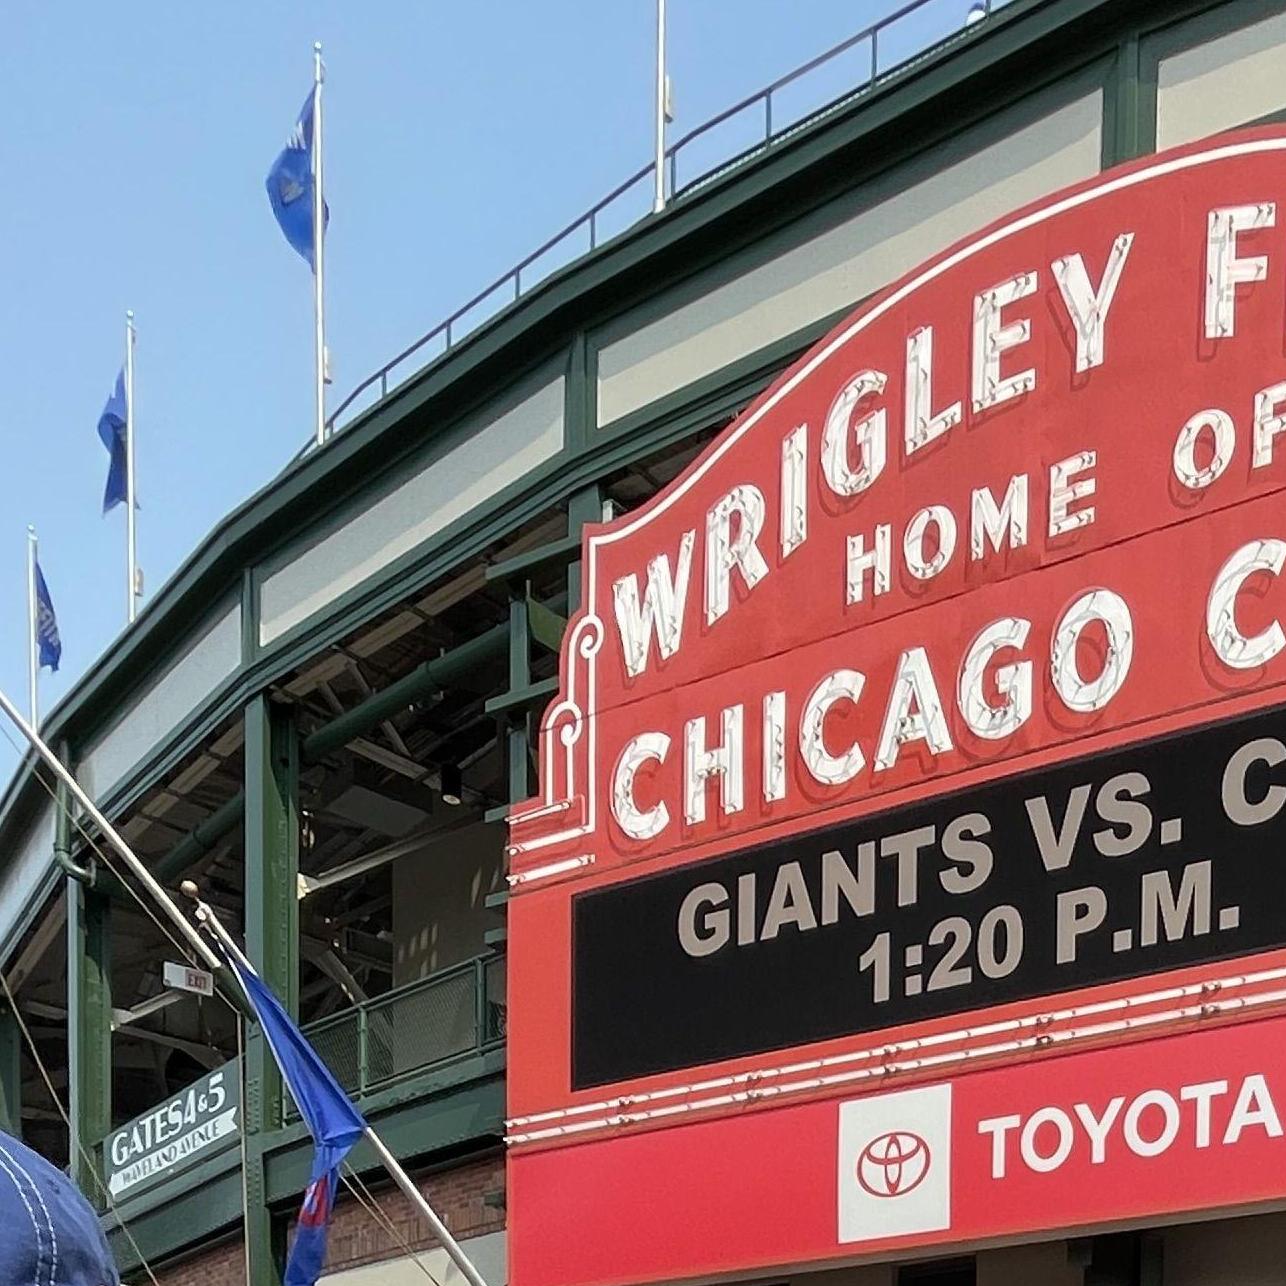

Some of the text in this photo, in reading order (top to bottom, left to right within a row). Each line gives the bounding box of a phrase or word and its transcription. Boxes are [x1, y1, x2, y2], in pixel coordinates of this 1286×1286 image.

[612, 232, 1134, 677] WRIGLEY
[846, 451, 1097, 605] HOME
[610, 586, 1134, 839] CHICAGO
[677, 813, 994, 958] GIANTS
[1025, 772, 1181, 870] VS.
[859, 861, 1239, 1002] 1:20 P.M.
[111, 1099, 182, 1166] GATES
[184, 1088, 196, 1124] 4
[208, 1072, 226, 1113] 5
[978, 1075, 1283, 1178] TOYOTA
